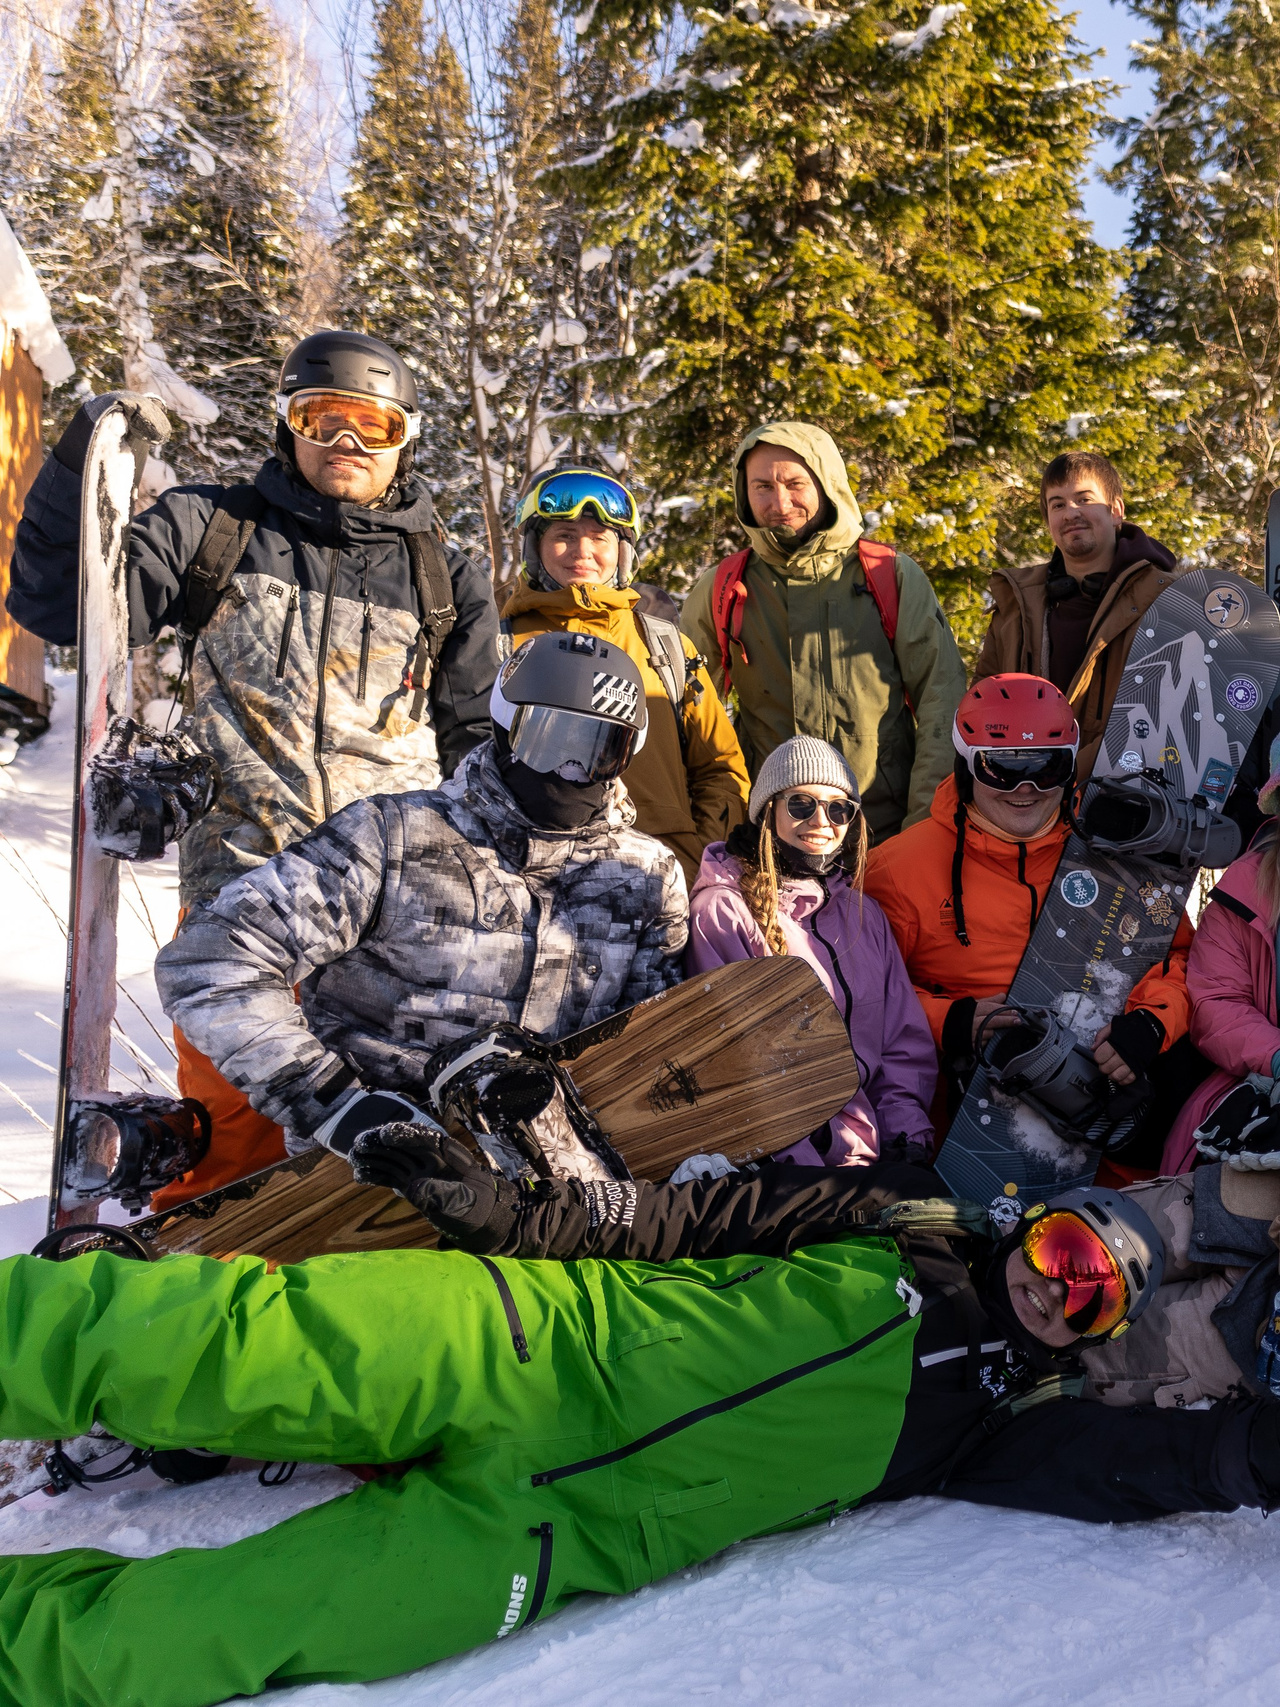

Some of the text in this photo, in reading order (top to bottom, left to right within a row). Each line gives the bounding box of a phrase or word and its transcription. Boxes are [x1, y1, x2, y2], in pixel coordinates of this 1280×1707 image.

[1101, 886, 1126, 936] BOREALIS
[1080, 940, 1106, 992] ARTEACT
[497, 1573, 528, 1639] SNOW
